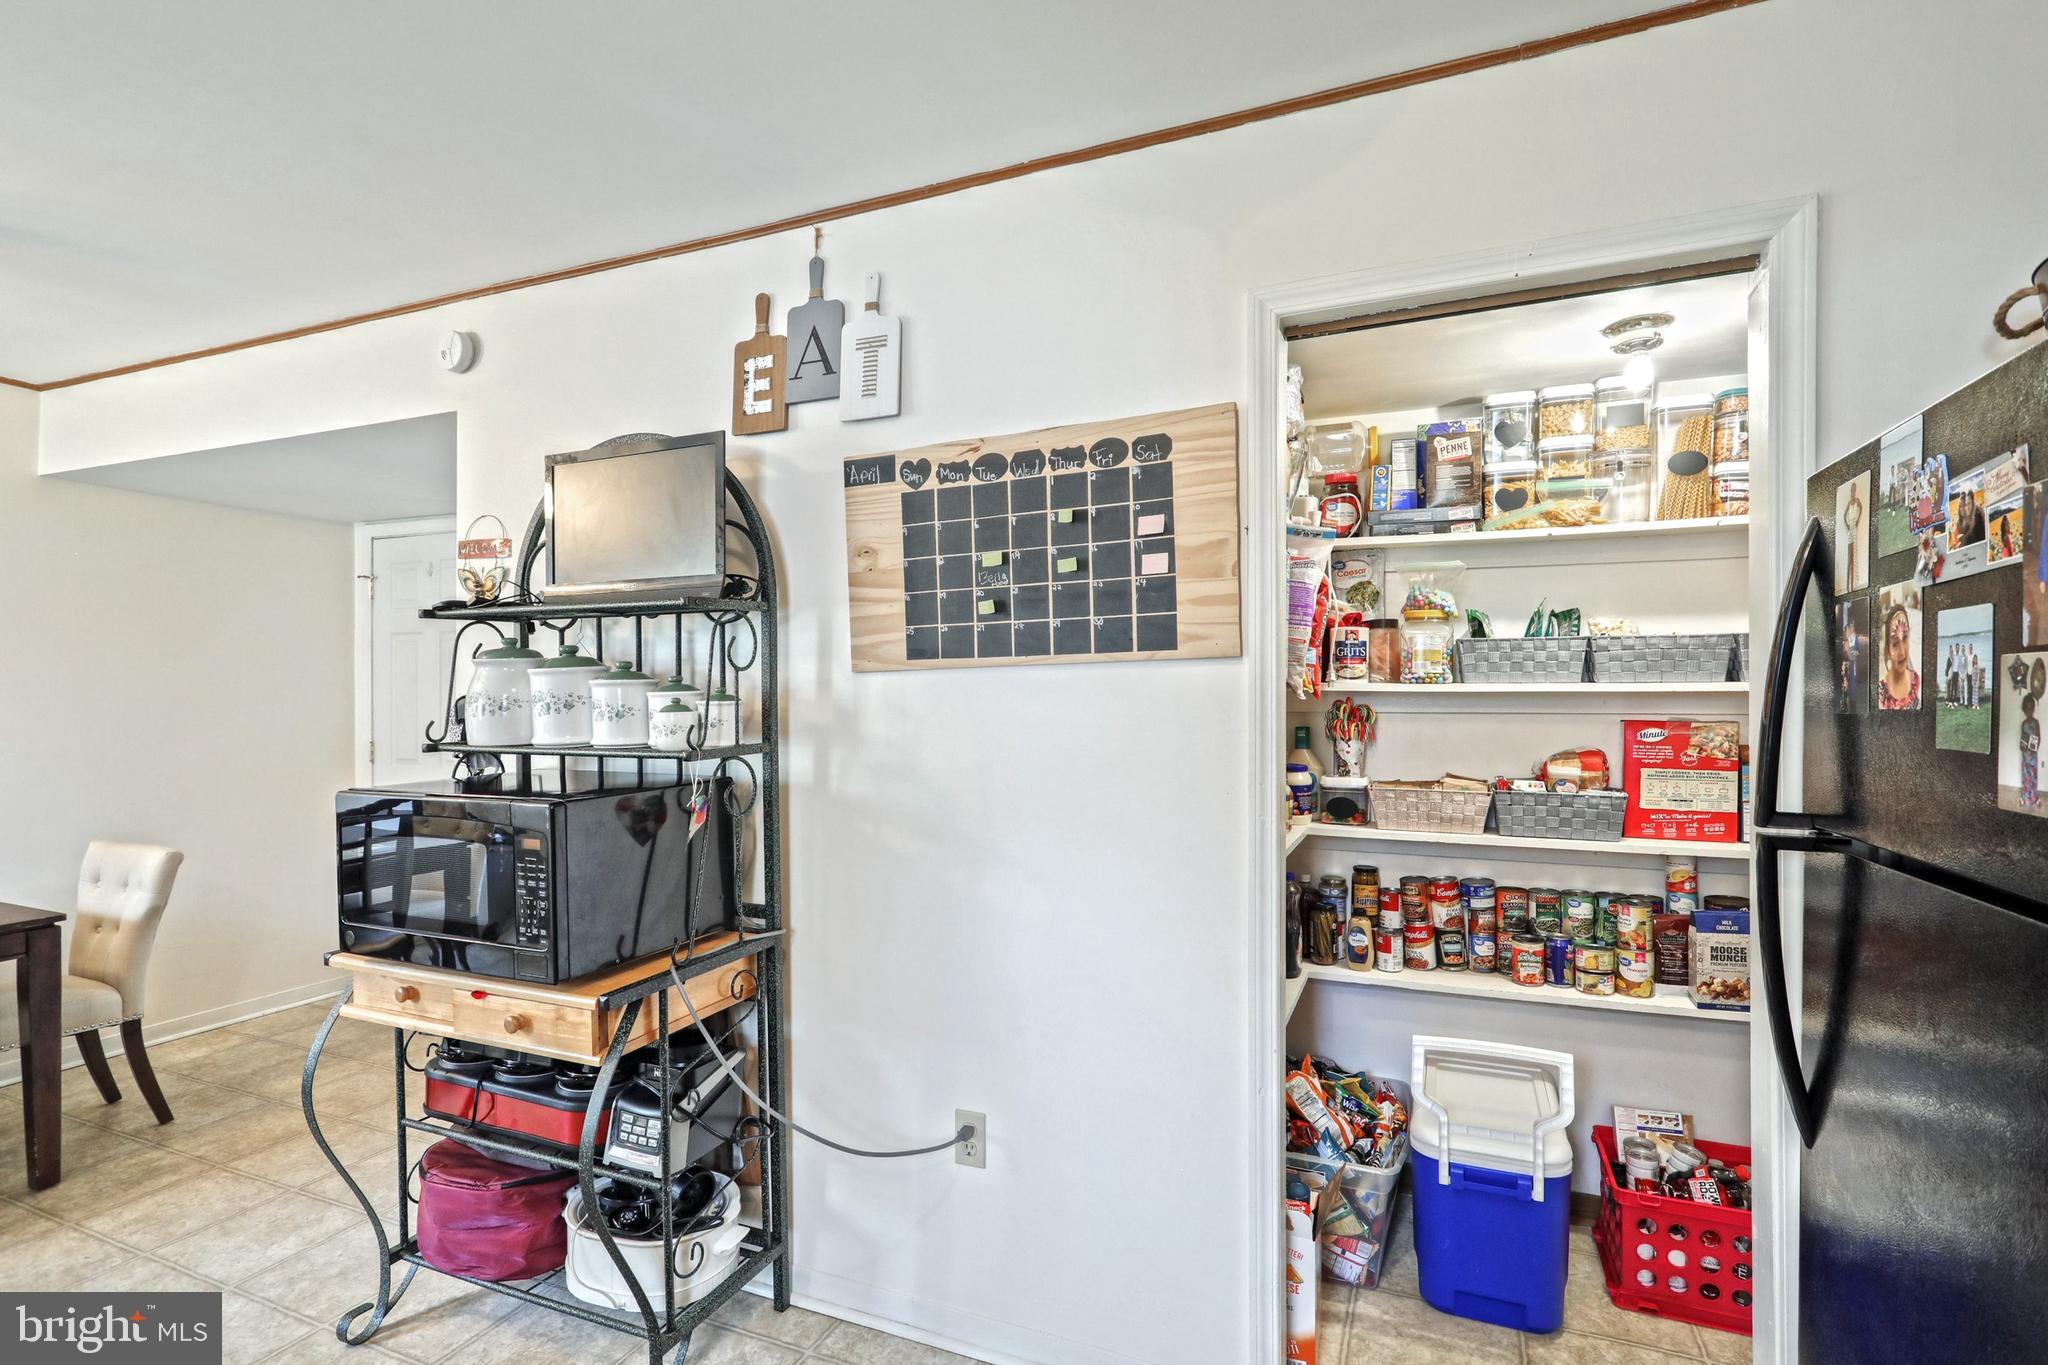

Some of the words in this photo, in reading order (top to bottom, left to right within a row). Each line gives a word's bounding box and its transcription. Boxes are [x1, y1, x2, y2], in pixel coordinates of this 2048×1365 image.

[1439, 440, 1469, 456] PENNE
[902, 467, 924, 484] Sun
[939, 466, 965, 482] Mon
[975, 466, 998, 482] Tue
[1012, 459, 1040, 478] Wed
[1051, 455, 1081, 470] Thur
[1091, 447, 1114, 467] Fri
[1135, 443, 1163, 461] Sat
[849, 464, 881, 485] April
[1336, 567, 1367, 578] Caesar
[1336, 646, 1367, 657] GRITS
[1709, 945, 1748, 955] MOOSE
[1710, 953, 1748, 963] MUNCH
